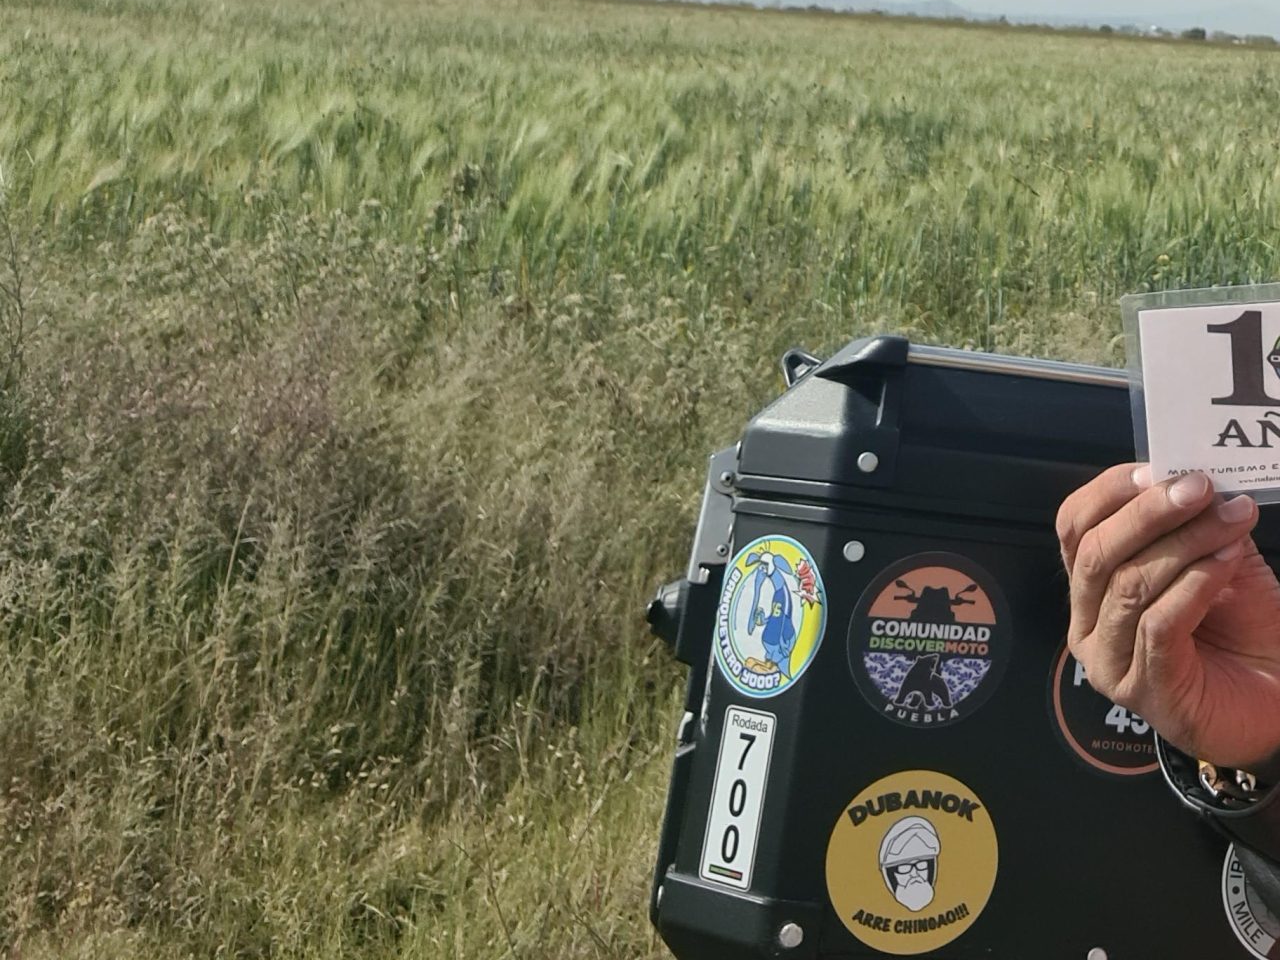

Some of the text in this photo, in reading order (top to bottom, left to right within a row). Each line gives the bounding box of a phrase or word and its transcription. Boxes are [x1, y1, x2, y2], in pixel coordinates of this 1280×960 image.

[1210, 464, 1266, 474] TURISMO
[719, 569, 742, 677] BANQUETERO
[871, 620, 991, 641] COMUNIDAD
[869, 637, 989, 655] DISCOVERMOTO
[732, 714, 768, 733] Rodada
[884, 703, 959, 723] PUEBLA
[847, 789, 981, 827] DUBANOK
[852, 908, 891, 932] ARRE
[1233, 901, 1264, 944] MILE
